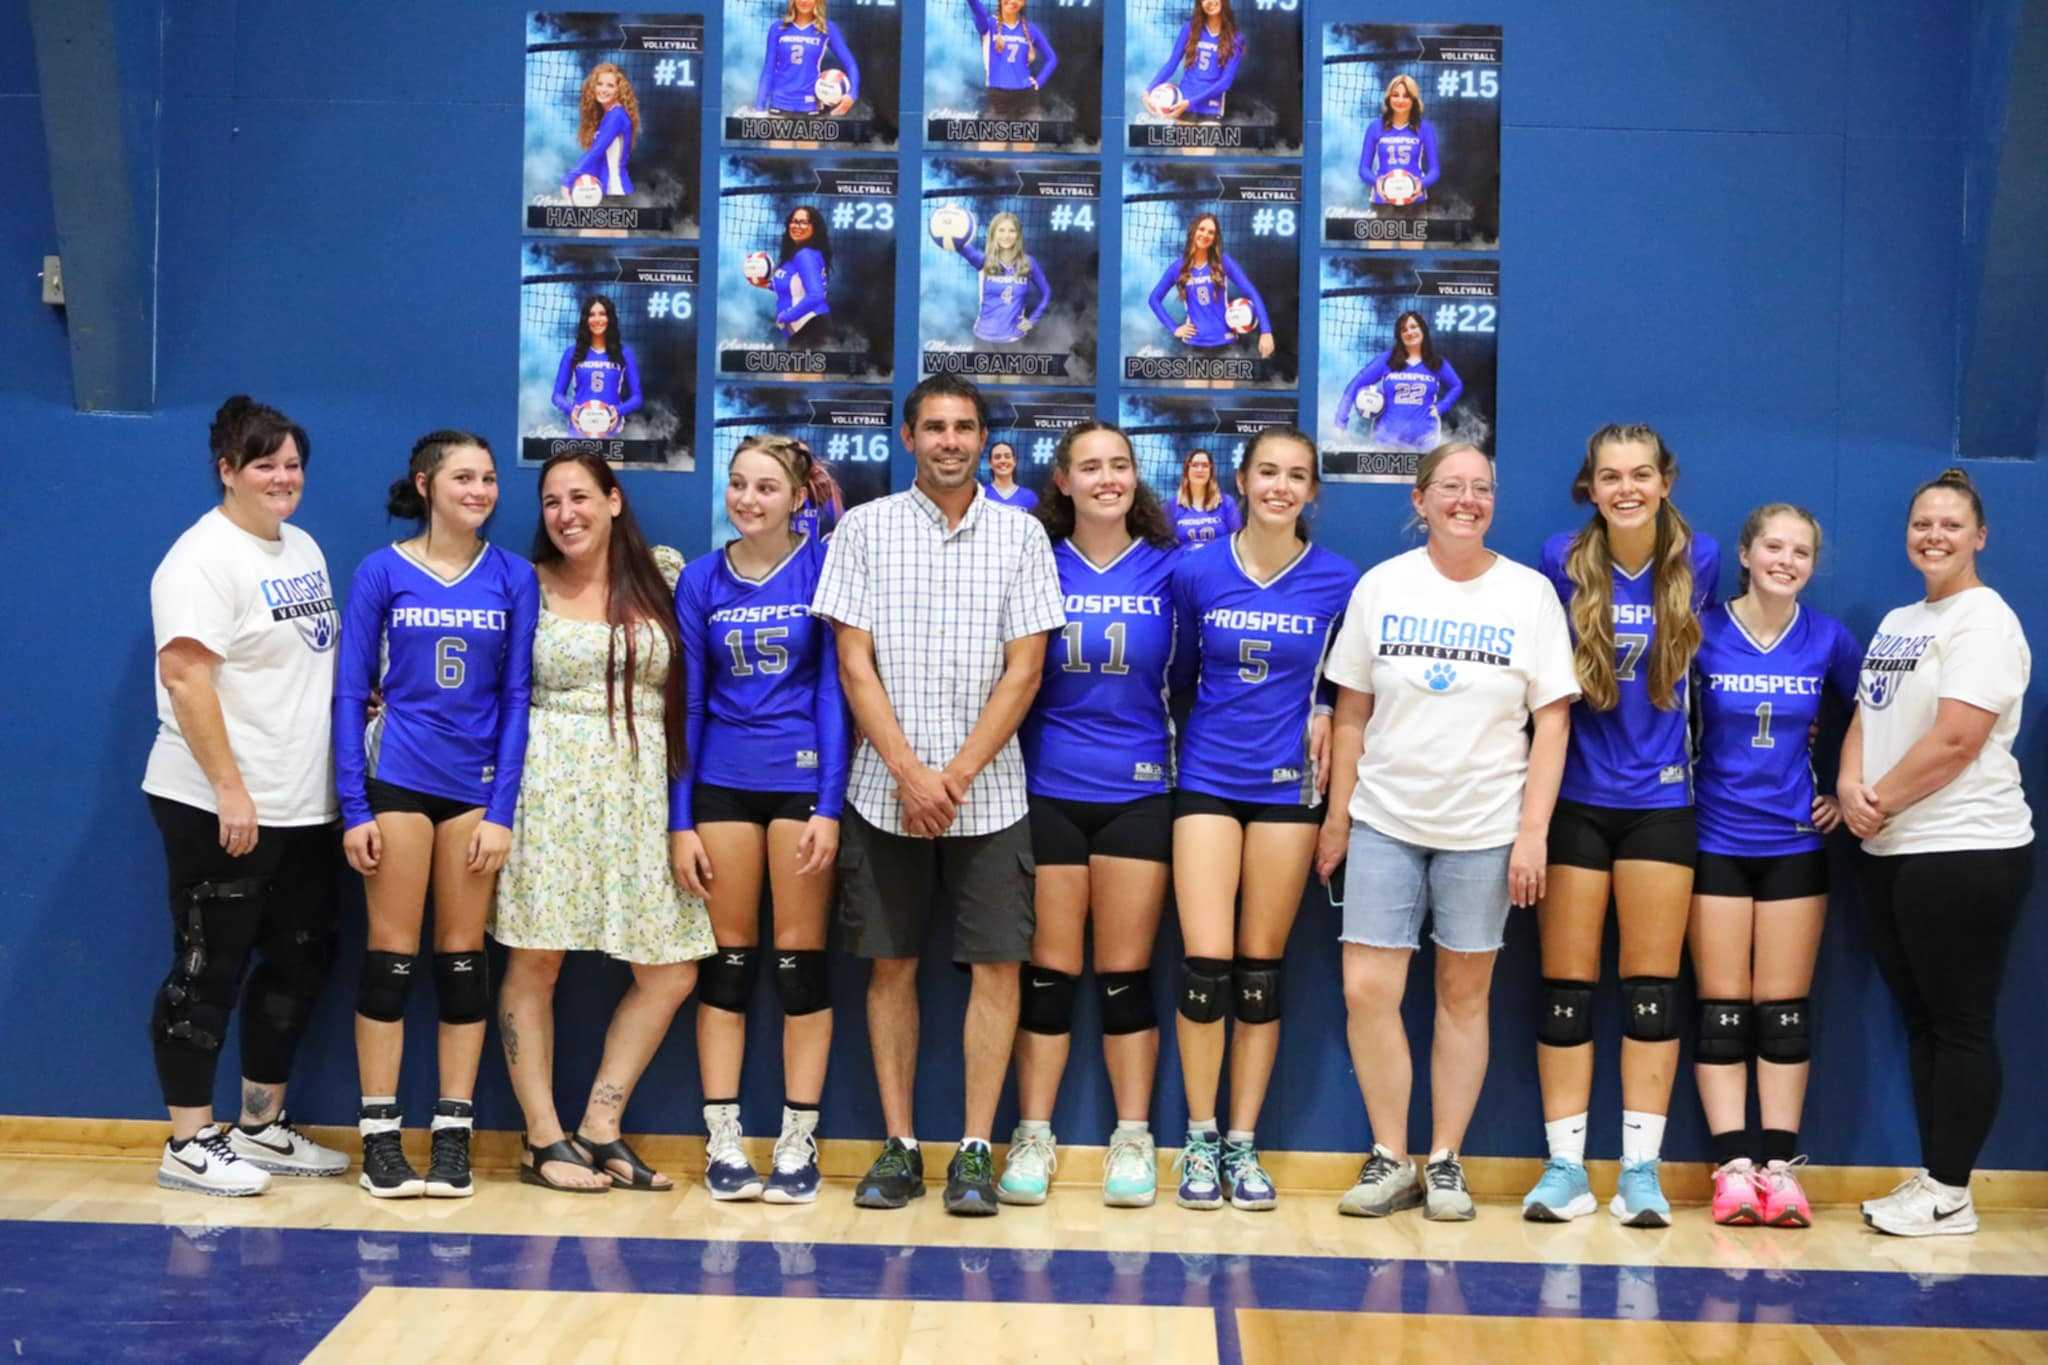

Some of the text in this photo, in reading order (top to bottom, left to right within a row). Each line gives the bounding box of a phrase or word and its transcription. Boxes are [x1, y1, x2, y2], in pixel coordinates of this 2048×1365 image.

[642, 41, 698, 50] VOLLEYBALL
[1007, 43, 1020, 63] 7
[1441, 51, 1496, 61] VOLLEYBALL
[653, 58, 696, 87] #1
[1437, 70, 1499, 98] #15
[741, 119, 840, 140] HOWARD
[947, 120, 1040, 141] HANSEN
[1148, 126, 1241, 146] LEHMAN
[836, 184, 892, 195] VOLLEYBALL
[1039, 187, 1095, 197] VOLLEYBALL
[1240, 191, 1296, 201] VOLLEYBALL
[547, 207, 639, 229] HANSEN
[832, 202, 894, 230] #23
[1051, 205, 1095, 232] #4
[1252, 209, 1296, 237] #8
[1354, 219, 1429, 240] GOBLE
[638, 273, 693, 283] VOLLEYBALL
[1437, 286, 1493, 296] VOLLEYBALL
[647, 292, 692, 319] #6
[1435, 305, 1497, 332] #22
[924, 353, 1053, 374] WOLGAMOT
[831, 416, 887, 425] VOLLEYBALL
[827, 434, 889, 462] #16
[1357, 454, 1419, 475] ROME
[1061, 594, 1162, 616] OSPECT
[392, 607, 507, 631] PROSPECT
[1204, 608, 1317, 636] PROSPECT
[1380, 614, 1516, 657] COUGARS
[724, 625, 790, 677] 15
[1061, 621, 1131, 676] 11
[1386, 644, 1501, 667] VOLLEYBALL
[1614, 632, 1649, 683] 7
[435, 636, 468, 689] 6
[1237, 638, 1272, 685] 5
[1709, 674, 1816, 695] PROSPECT
[1751, 702, 1775, 749] 1
